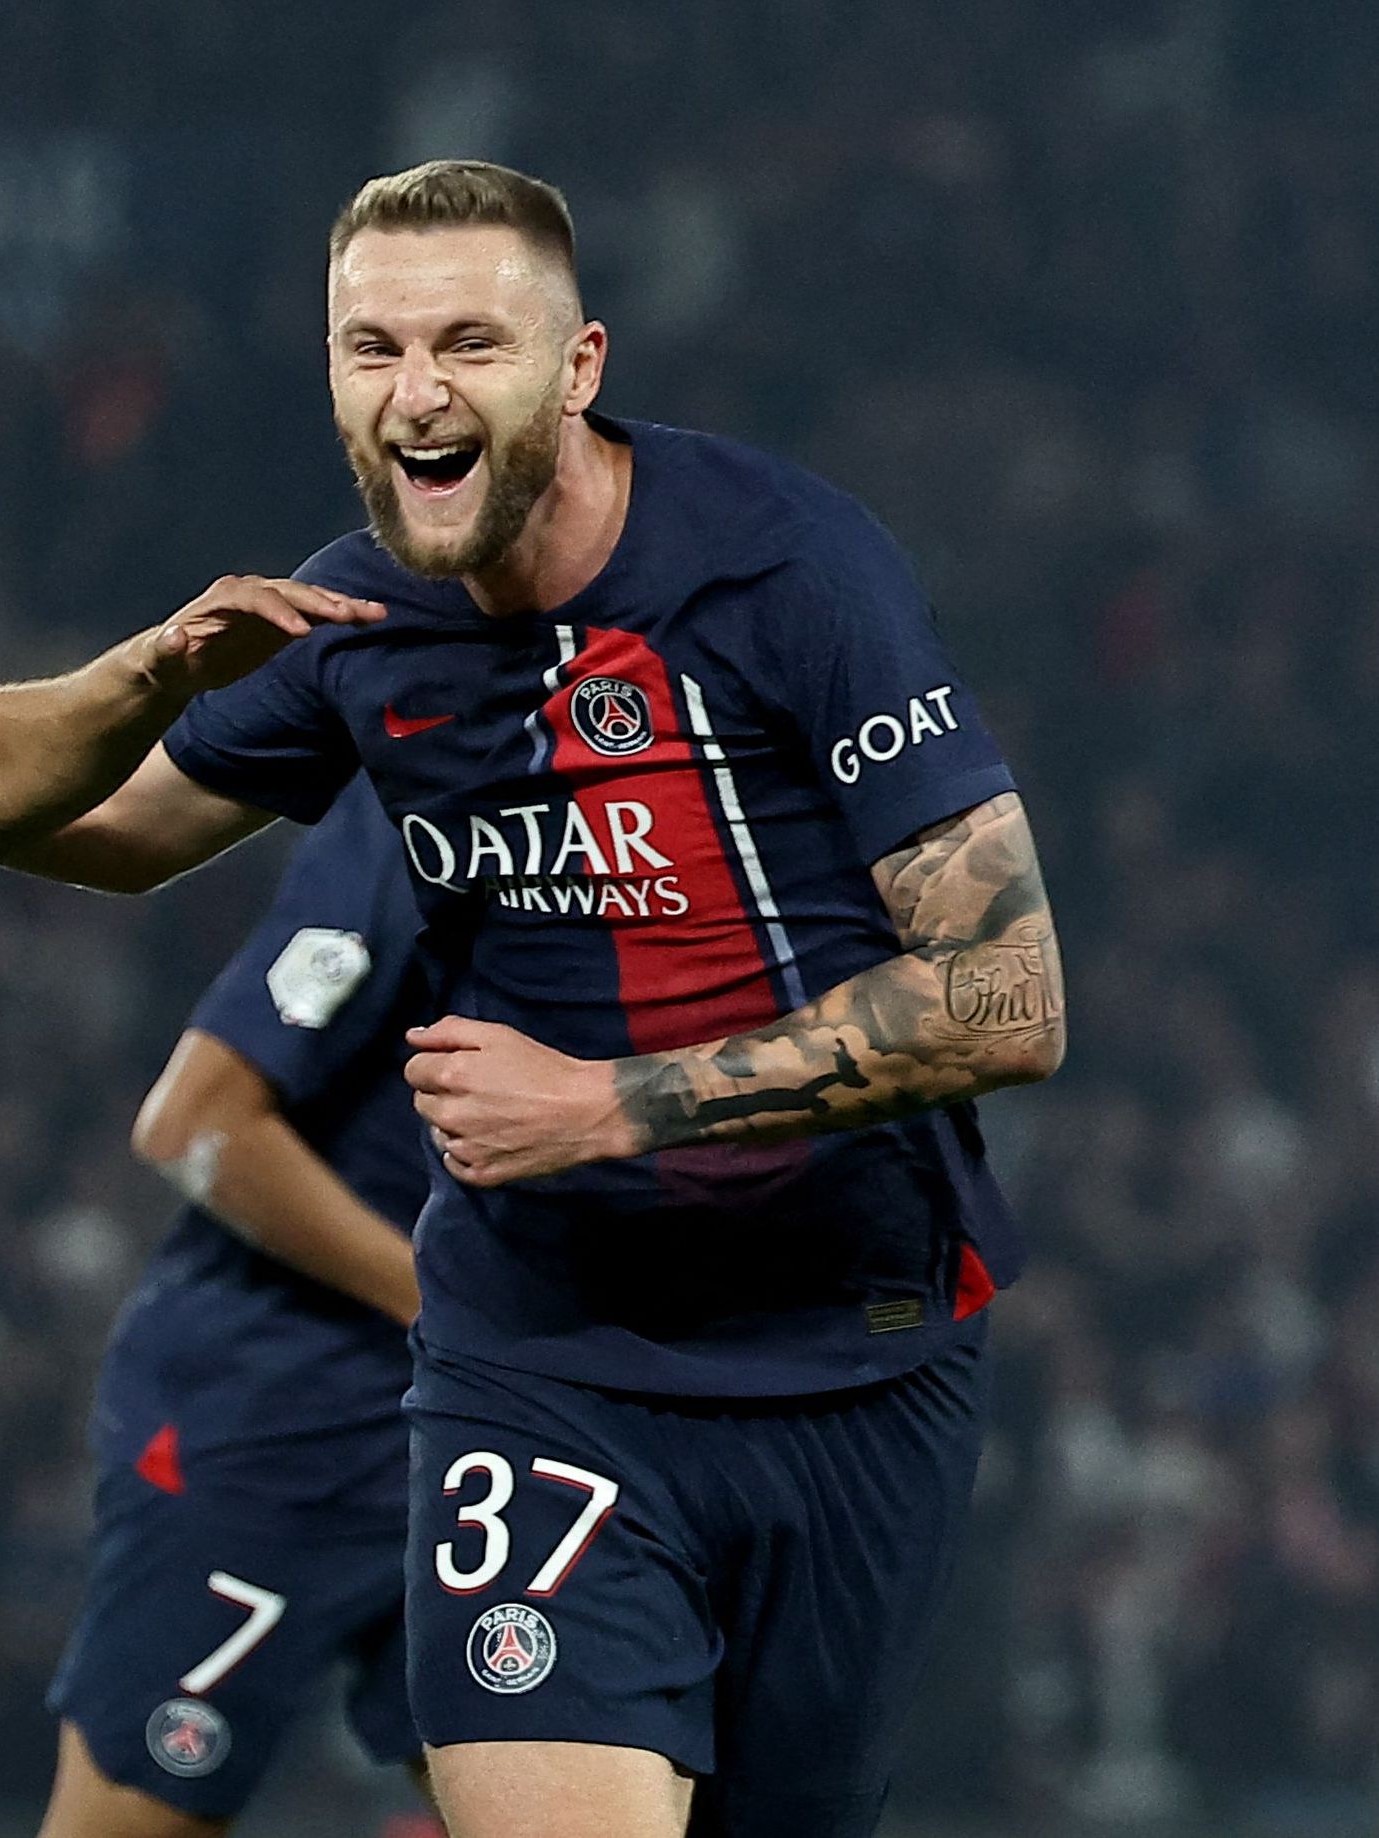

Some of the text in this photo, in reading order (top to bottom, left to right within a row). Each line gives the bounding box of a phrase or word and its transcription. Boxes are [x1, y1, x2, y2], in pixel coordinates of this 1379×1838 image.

[579, 681, 632, 700] PARIS
[831, 685, 959, 785] GOAT
[403, 801, 674, 893] QATAR
[435, 1451, 620, 1596] 37
[178, 1569, 287, 1695] 7
[481, 1608, 540, 1631] PARIS
